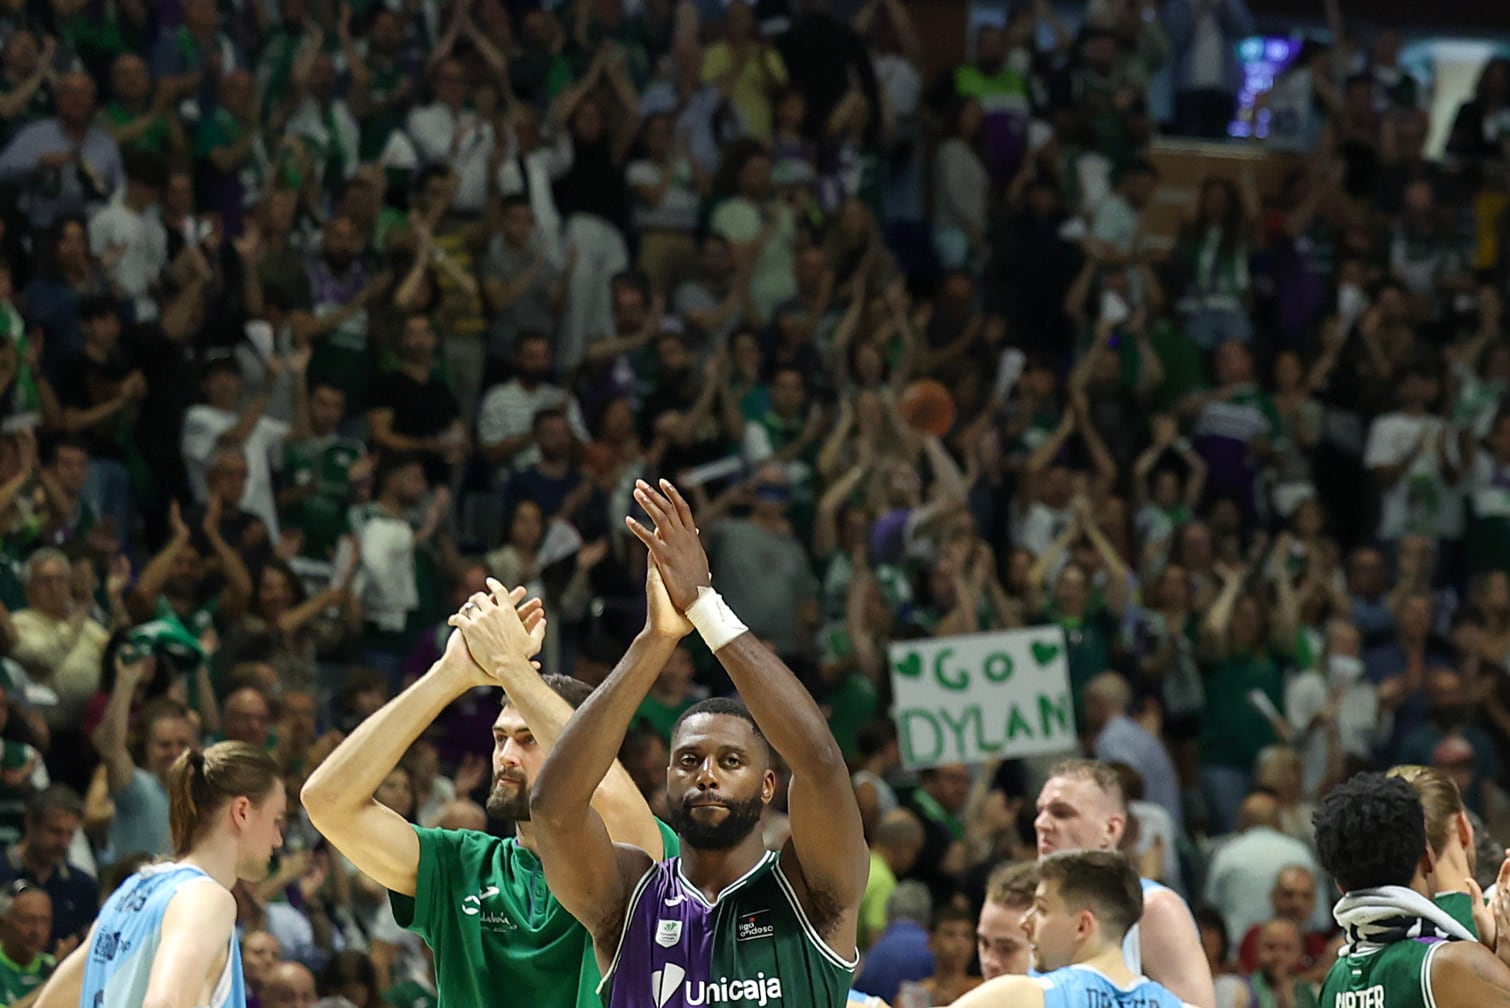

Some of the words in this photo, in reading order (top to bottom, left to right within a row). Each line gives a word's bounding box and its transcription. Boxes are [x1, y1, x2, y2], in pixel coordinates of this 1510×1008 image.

[935, 648, 1014, 690] GO
[901, 691, 1069, 764] DYLAN
[685, 972, 783, 1007] Unicaja
